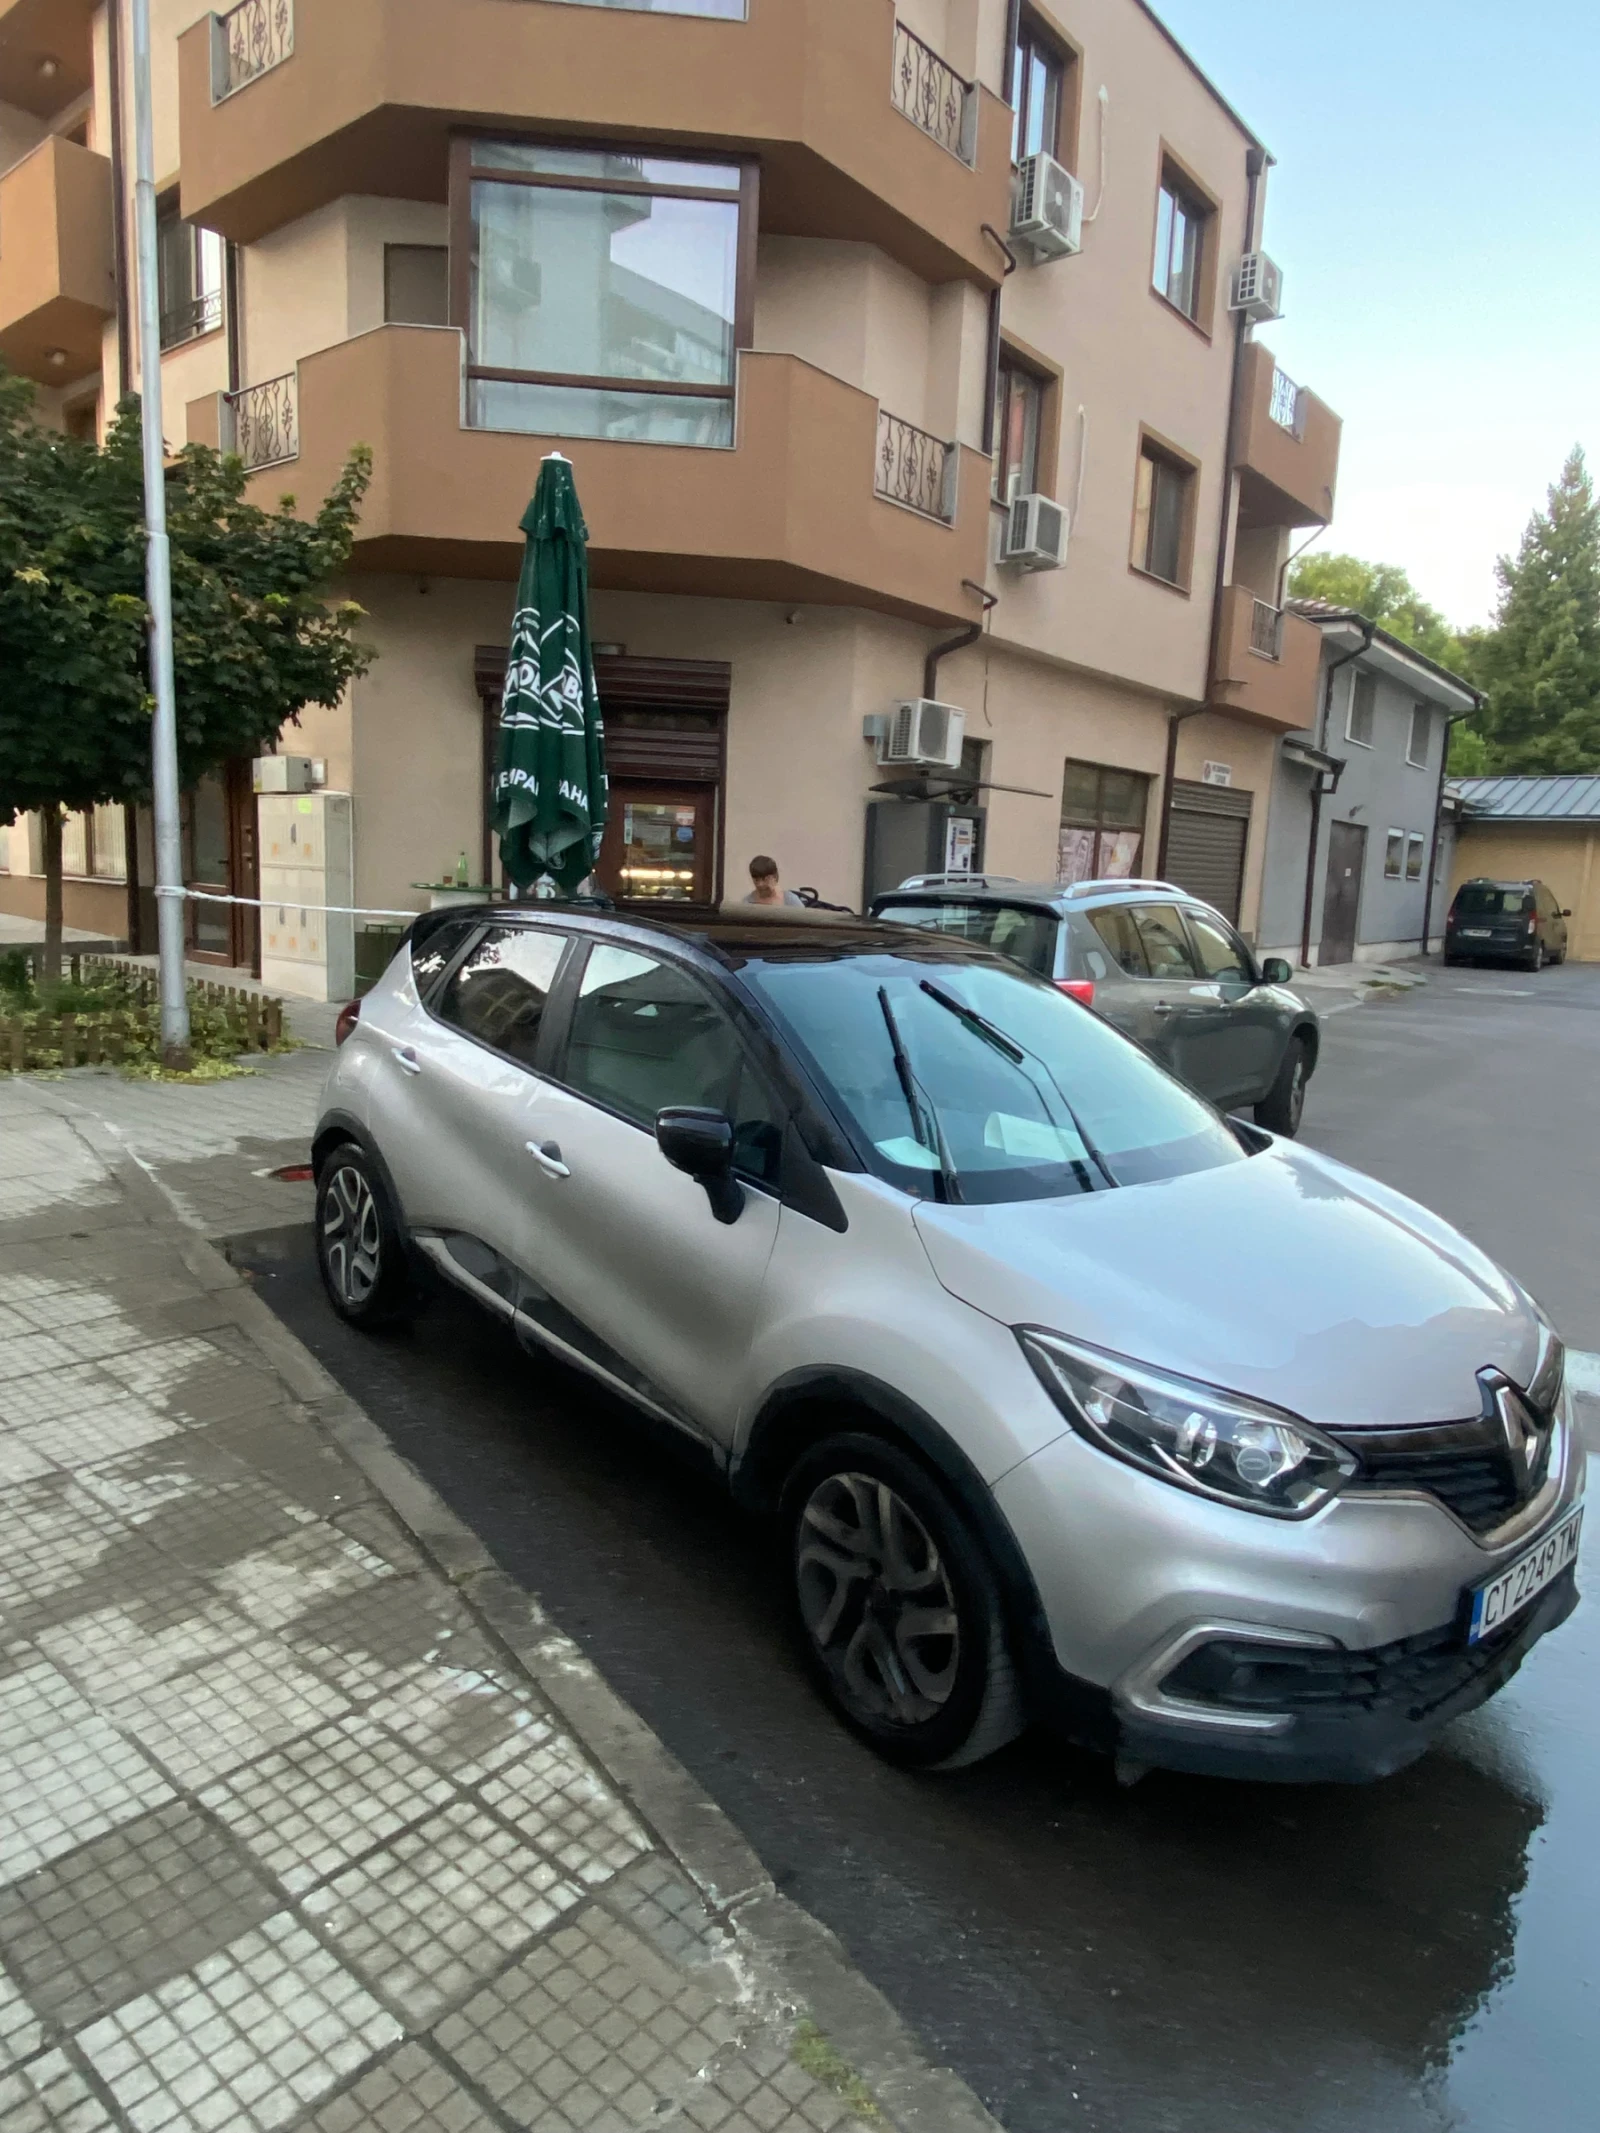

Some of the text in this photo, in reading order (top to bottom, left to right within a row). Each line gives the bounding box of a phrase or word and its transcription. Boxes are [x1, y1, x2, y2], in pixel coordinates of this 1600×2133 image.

[1485, 1517, 1579, 1626] CT 2249 TM
